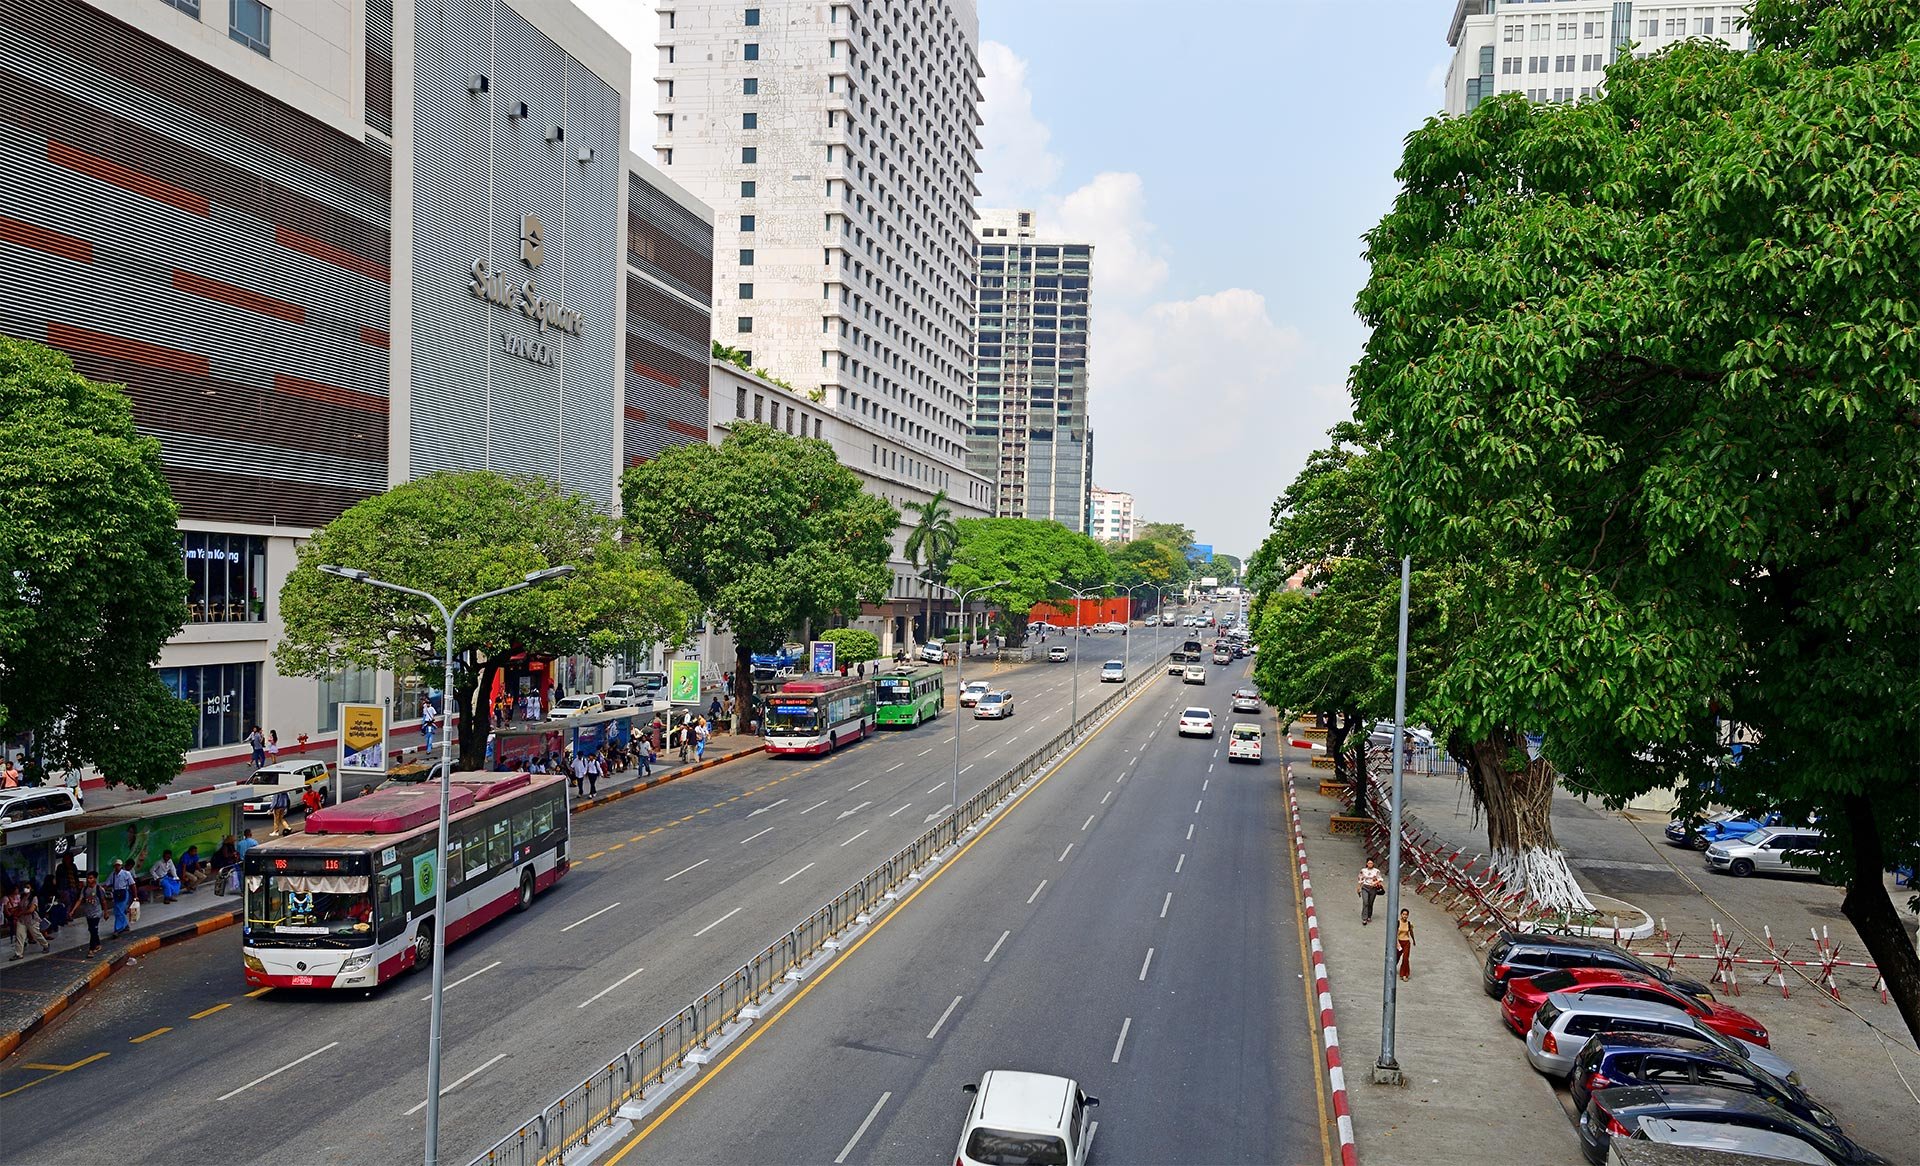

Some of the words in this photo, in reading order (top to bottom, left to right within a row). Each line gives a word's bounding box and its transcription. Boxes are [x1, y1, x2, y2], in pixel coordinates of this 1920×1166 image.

[469, 257, 518, 309] Sule
[519, 279, 586, 336] Square
[503, 330, 556, 368] YANGON
[275, 859, 287, 869] YBS
[325, 859, 339, 870] 116
